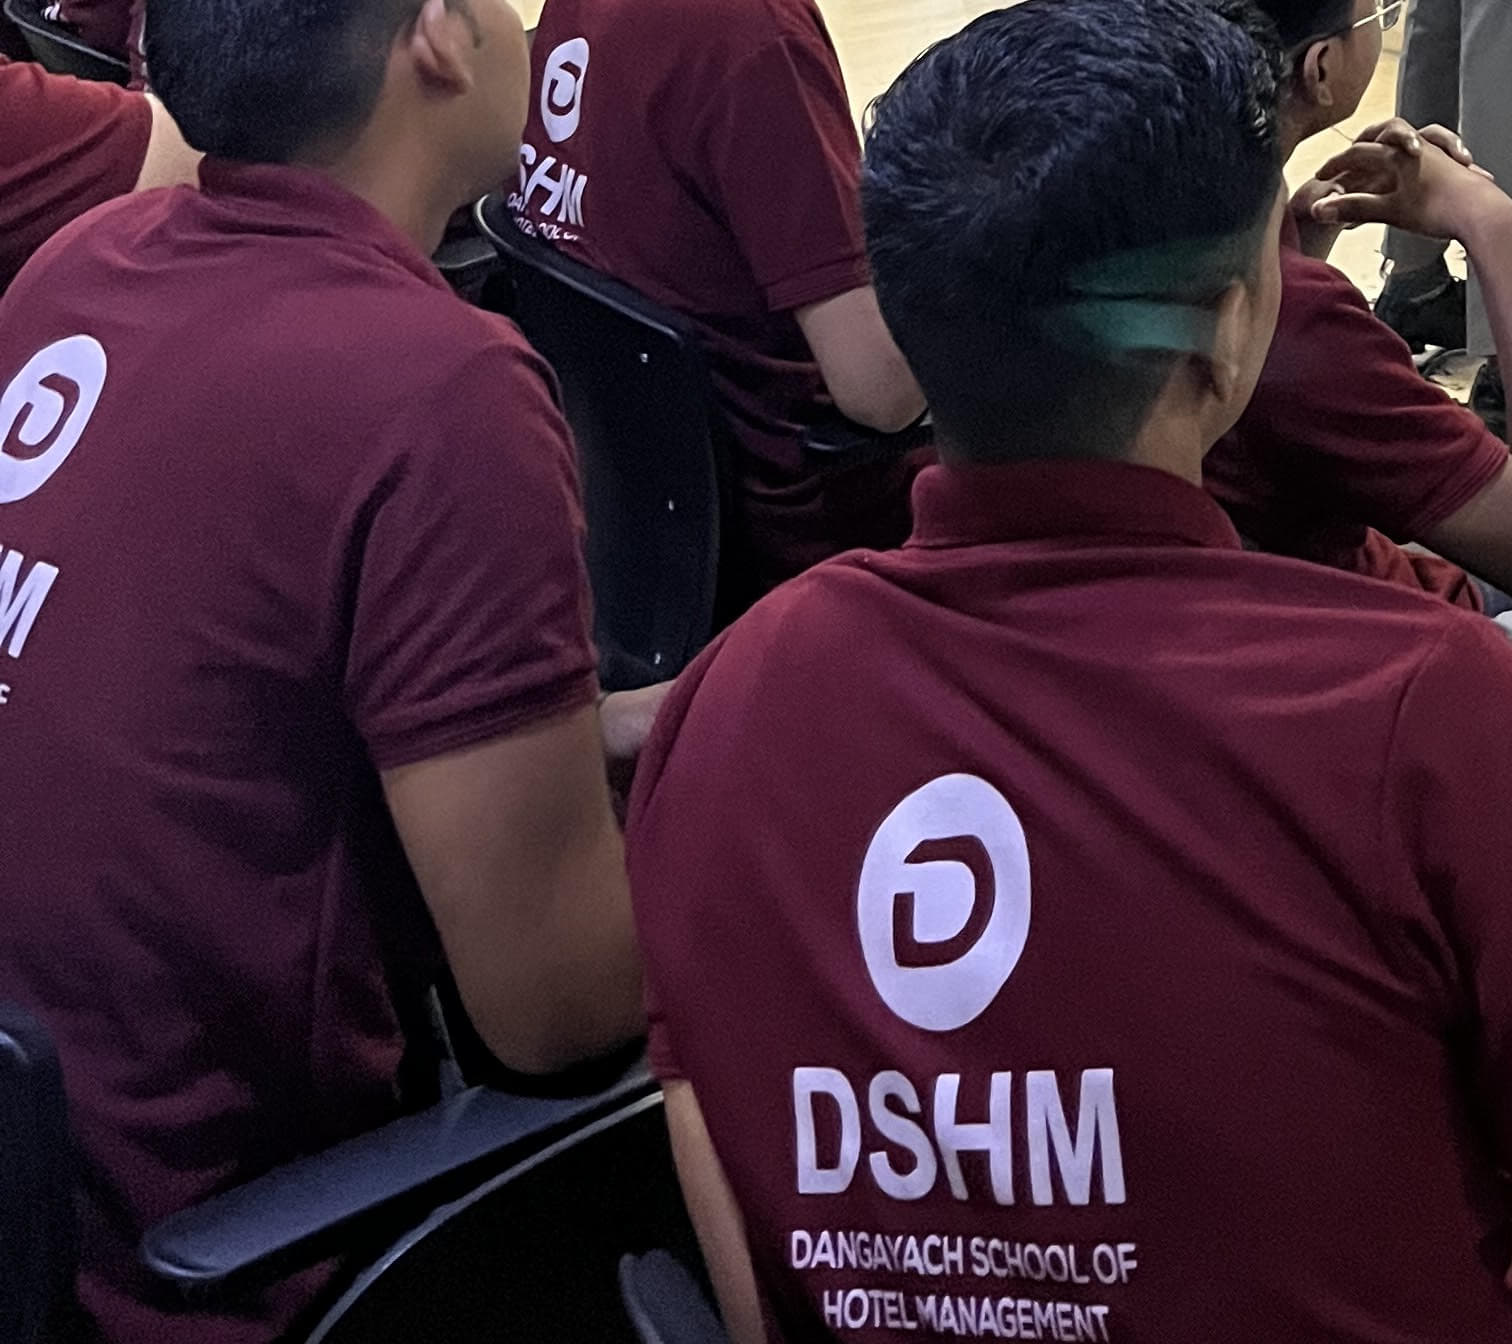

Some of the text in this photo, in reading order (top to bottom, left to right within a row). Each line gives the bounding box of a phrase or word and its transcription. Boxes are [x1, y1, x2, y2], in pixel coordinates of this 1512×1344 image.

[792, 1066, 1127, 1207] DSHM
[791, 1230, 1137, 1285] DANGAYACH SCHOOL OF
[823, 1288, 1109, 1343] HOTEL MANAGEMENT
